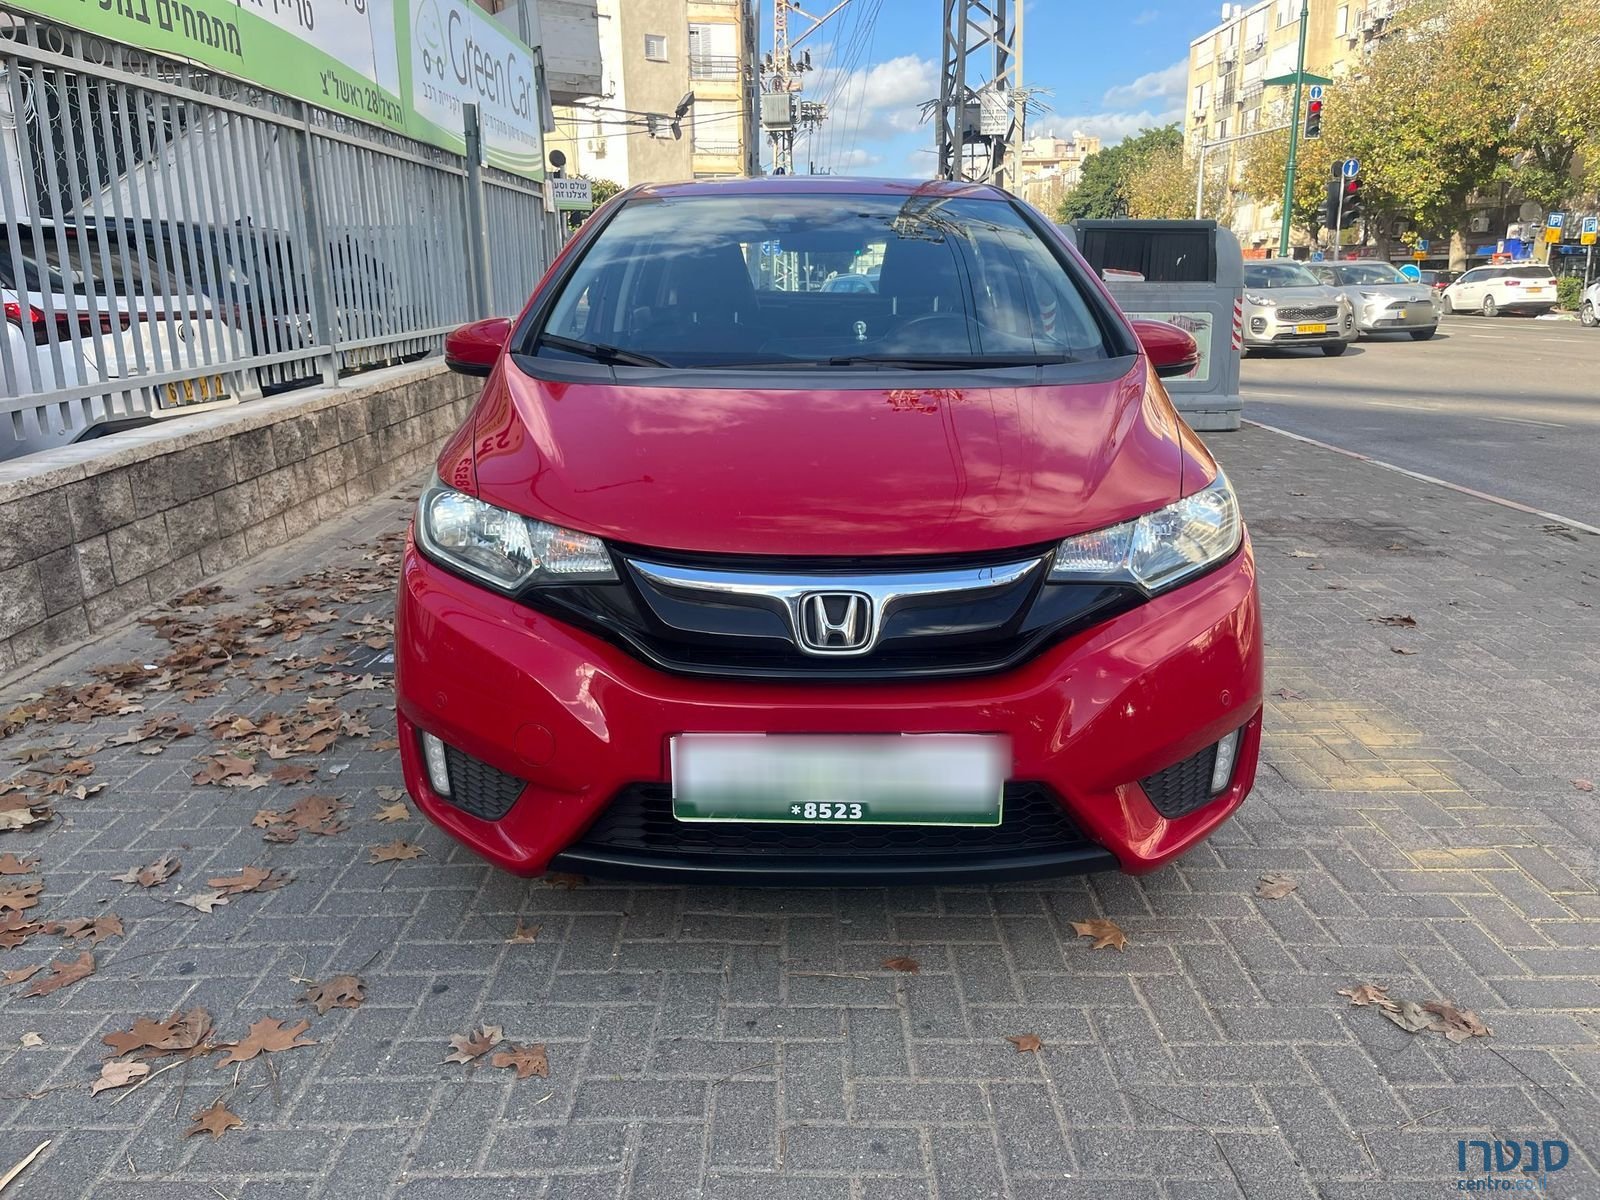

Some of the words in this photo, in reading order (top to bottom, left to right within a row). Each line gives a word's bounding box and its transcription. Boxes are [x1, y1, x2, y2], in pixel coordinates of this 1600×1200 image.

[155, 0, 242, 56] מתמחים
[448, 9, 506, 108] Green
[507, 52, 532, 122] Car
[365, 87, 379, 115] 28
[565, 190, 588, 199] אצלנו
[570, 181, 587, 190] שלם
